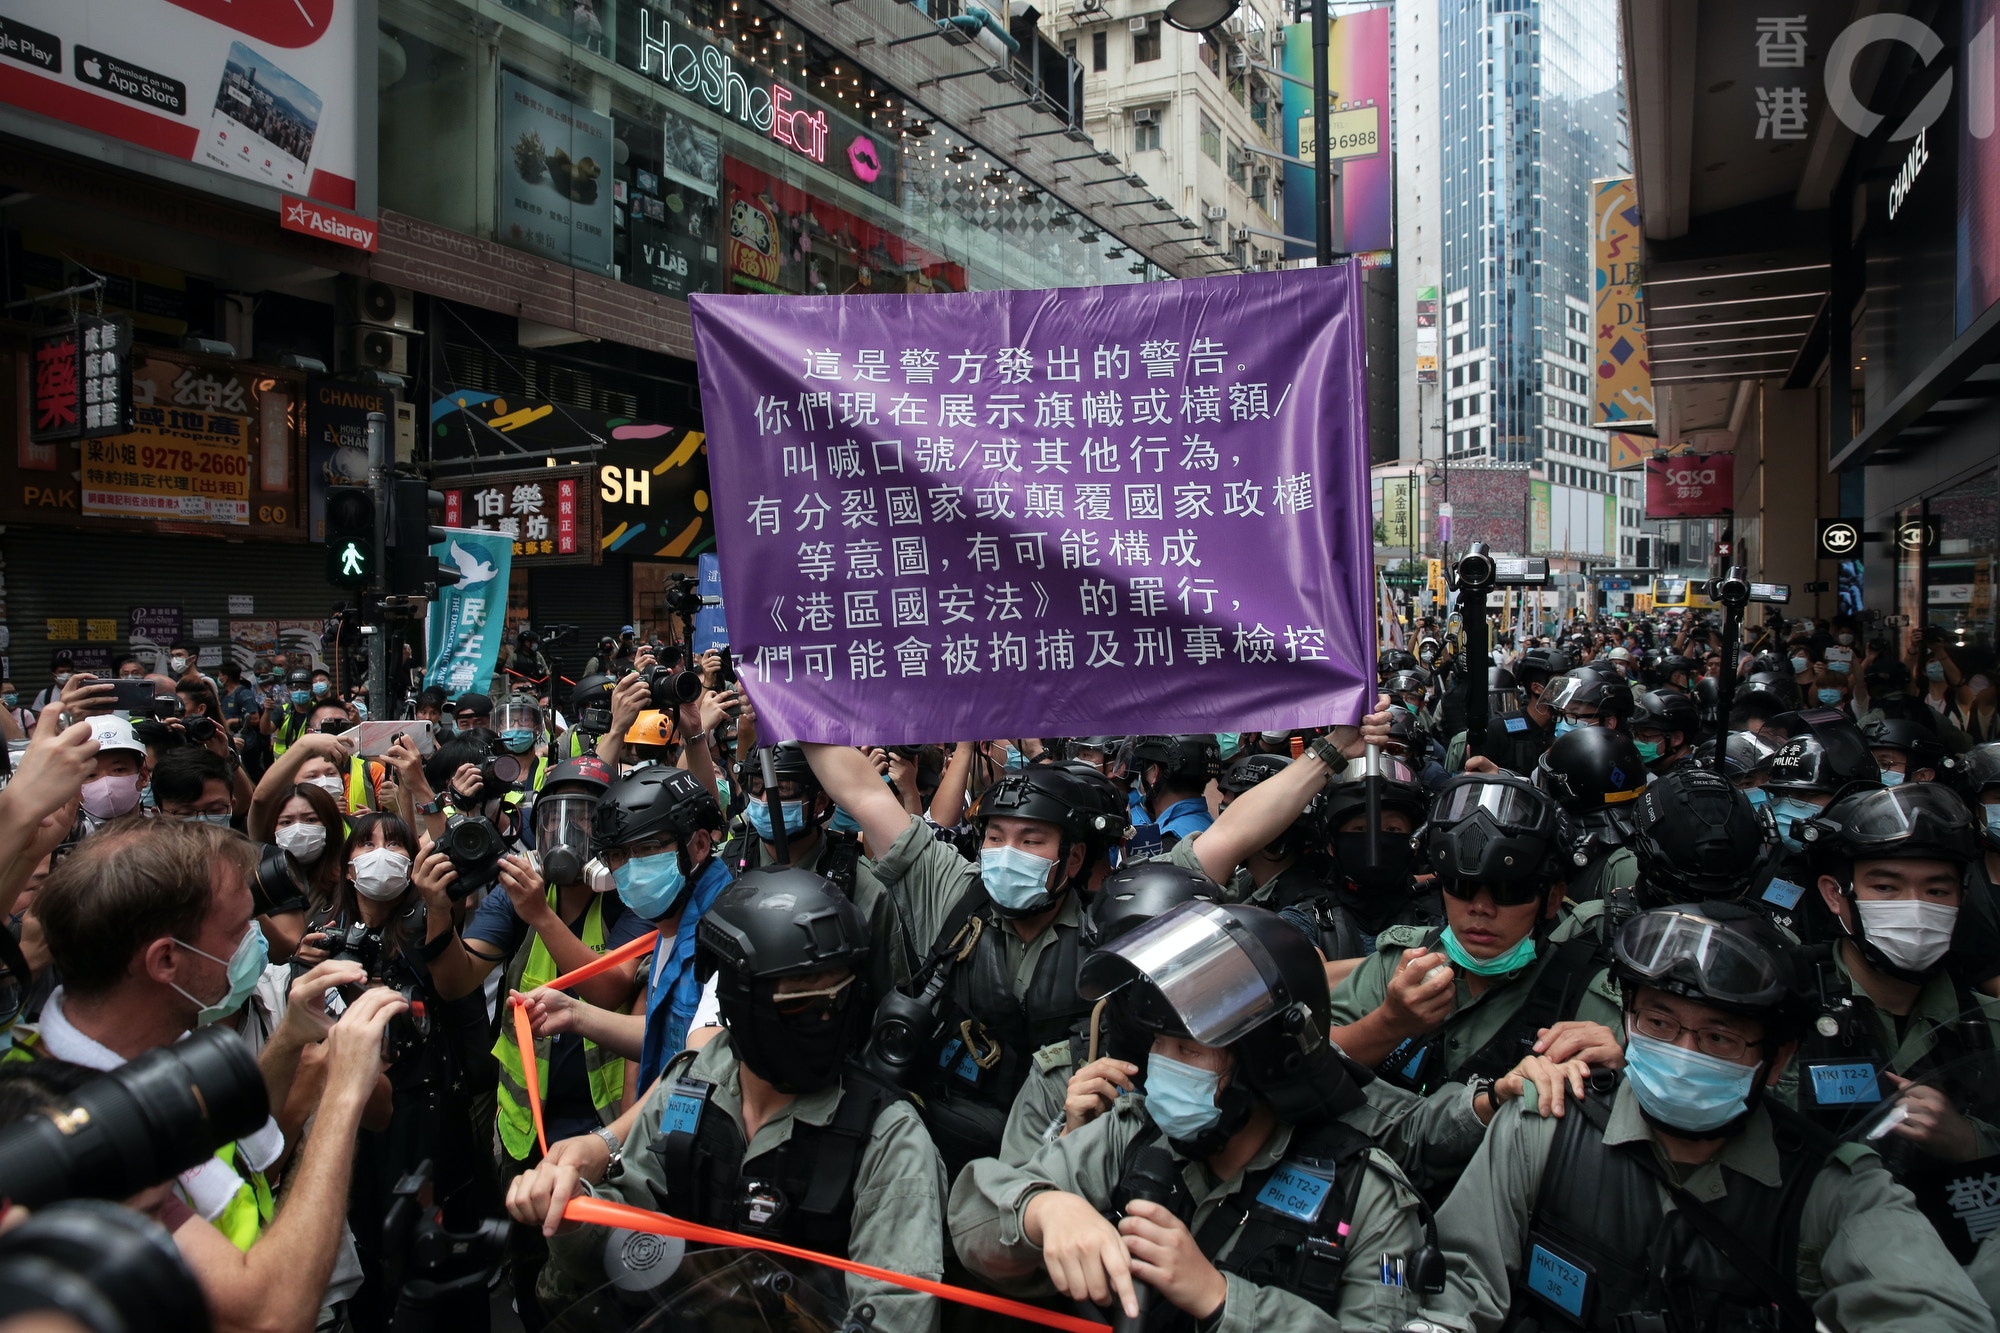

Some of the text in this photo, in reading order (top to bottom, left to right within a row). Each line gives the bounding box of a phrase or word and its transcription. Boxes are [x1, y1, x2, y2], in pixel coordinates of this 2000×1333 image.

[20, 39, 53, 66] Play
[107, 72, 179, 108] App Store
[108, 62, 175, 93] Download on the
[1301, 131, 1376, 154] 569 6988
[1889, 126, 1929, 221] CHANEL
[309, 215, 373, 250] Asiaray
[381, 208, 481, 262] Causeway
[489, 242, 536, 276] Place
[402, 258, 492, 305] Causeway
[803, 337, 1246, 385] 這是警方發出的警告。
[319, 386, 385, 413] CHANGE
[159, 427, 241, 447] Property
[323, 423, 370, 450] EXCHAN
[87, 440, 247, 477] 梁小姐 9278-2660
[24, 485, 77, 509] PAK
[473, 483, 545, 517] 伯樂
[747, 472, 1314, 536] 有分裂國家或顛覆國家政權
[258, 504, 288, 525] CO
[796, 528, 1202, 583] 等意圖，有可能構成
[451, 596, 461, 611] THE
[442, 612, 459, 667] DEMOCRATIC
[713, 625, 725, 634] This
[446, 597, 487, 692] 民主黨
[1771, 756, 1801, 768] POLICE
[1816, 1068, 1869, 1082] HKI T2-2
[1839, 1084, 1855, 1096] 1/8
[682, 1102, 697, 1115] T2-2
[1296, 1178, 1322, 1197] T2-2
[1287, 1194, 1310, 1213] Cdr
[1535, 1253, 1580, 1288] HKI T2-2
[1546, 1278, 1563, 1297] 3/5
